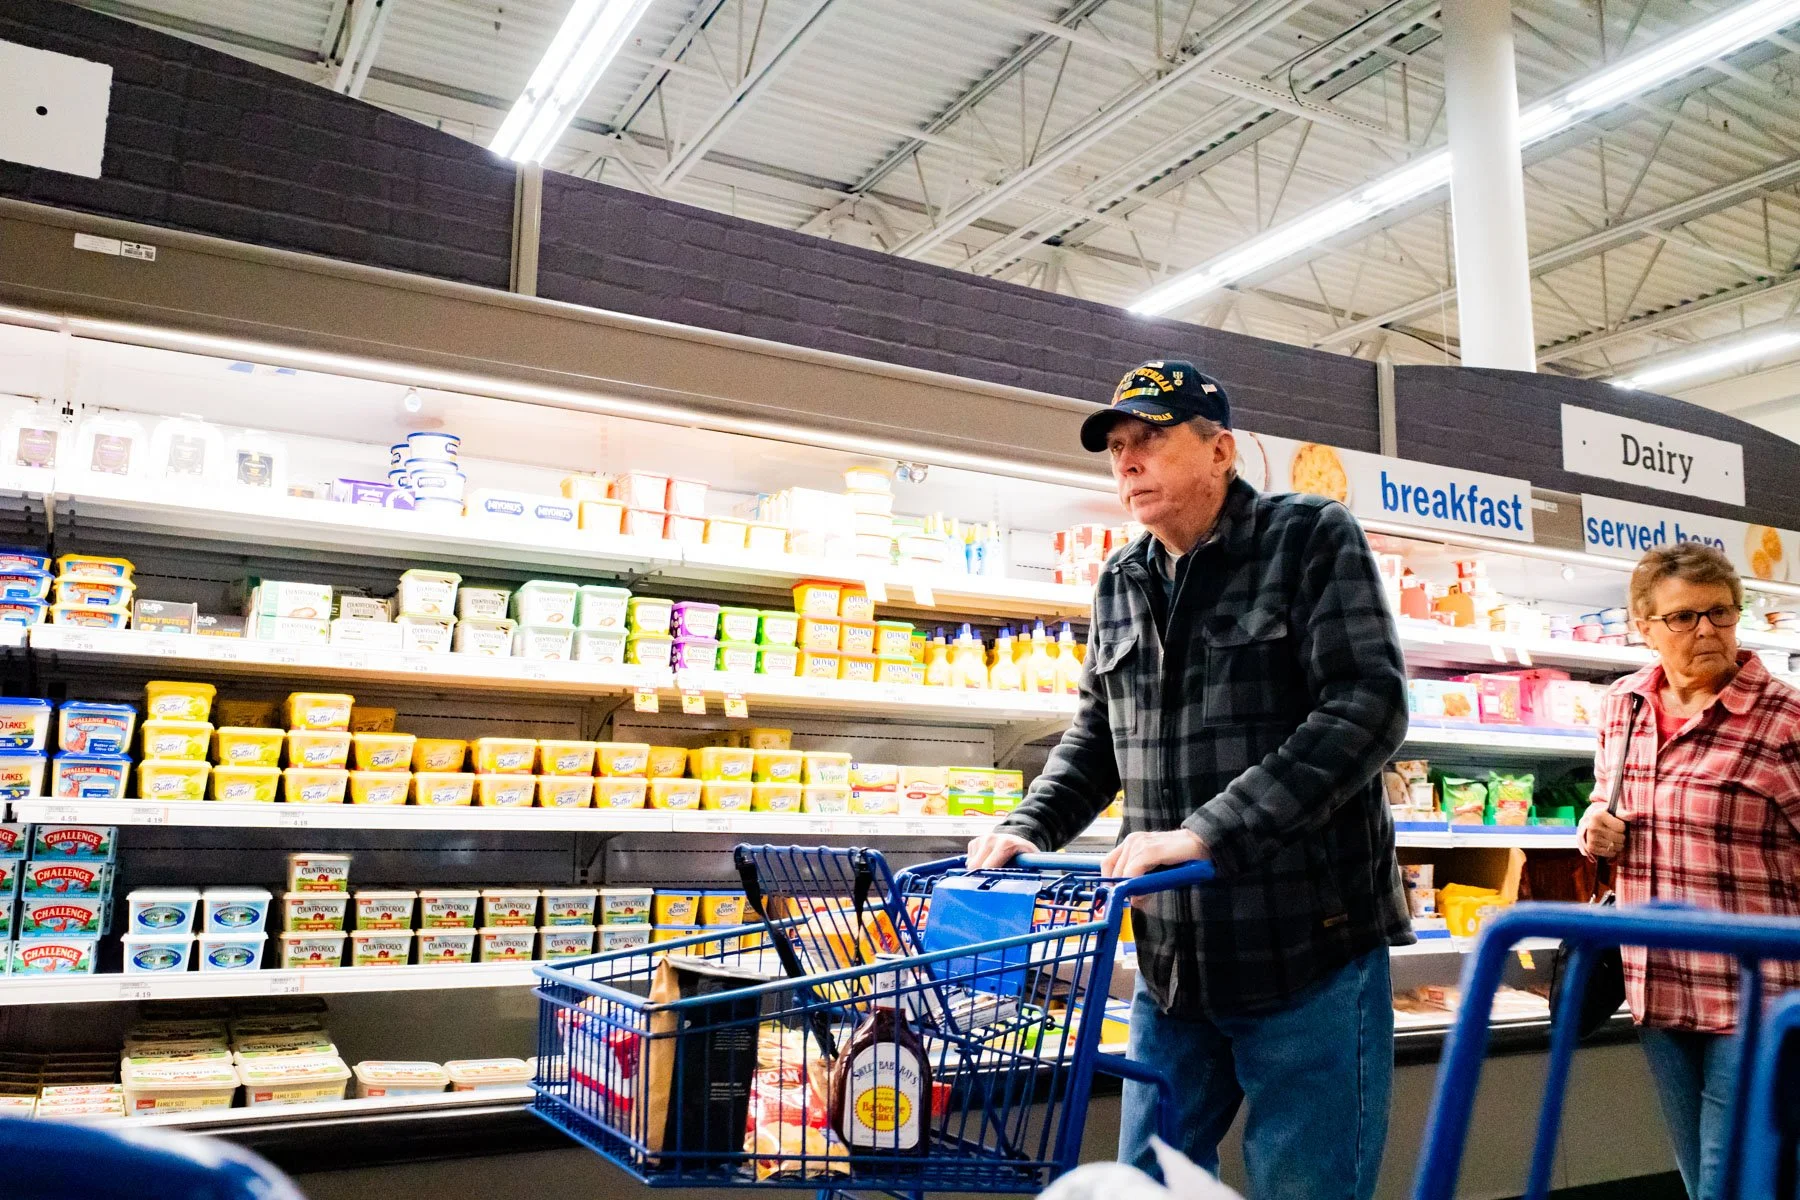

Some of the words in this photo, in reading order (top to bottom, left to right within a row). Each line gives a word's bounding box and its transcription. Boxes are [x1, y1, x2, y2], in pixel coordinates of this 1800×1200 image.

[1621, 433, 1694, 484] Dairy
[1381, 471, 1524, 531] breakfast
[1587, 517, 1666, 552] served
[814, 623, 838, 633] OLIVIO
[848, 628, 872, 637] OLIVIO
[886, 631, 909, 641] OLIVIO
[812, 658, 836, 668] OLIVIO
[849, 662, 873, 672] OLIVIO
[887, 665, 910, 674] OLIVIO
[157, 701, 186, 713] Butter!
[69, 716, 104, 727] CHALLENGE
[106, 717, 128, 731] BUTTER
[307, 712, 336, 724] Butter!
[5, 721, 27, 730] LAKES
[154, 740, 183, 753] Butter!
[229, 745, 257, 759] Butter!
[305, 749, 333, 762] Butter!
[371, 752, 399, 766] Butter!
[1, 772, 24, 782] LAKES
[61, 766, 98, 777] CHALLENGE
[99, 767, 121, 780] BUTTER
[152, 779, 181, 793] Butter!
[224, 785, 251, 799] Butter!
[302, 787, 329, 801] Butter!
[46, 829, 99, 846] CHALLENGE
[37, 868, 91, 882] CHALLENGE
[34, 907, 88, 921] CHALLENGE
[24, 946, 79, 962] CHALLENGE
[853, 1062, 877, 1081] SWEE
[879, 1060, 897, 1071] BAB
[862, 1101, 906, 1115] Barbece
